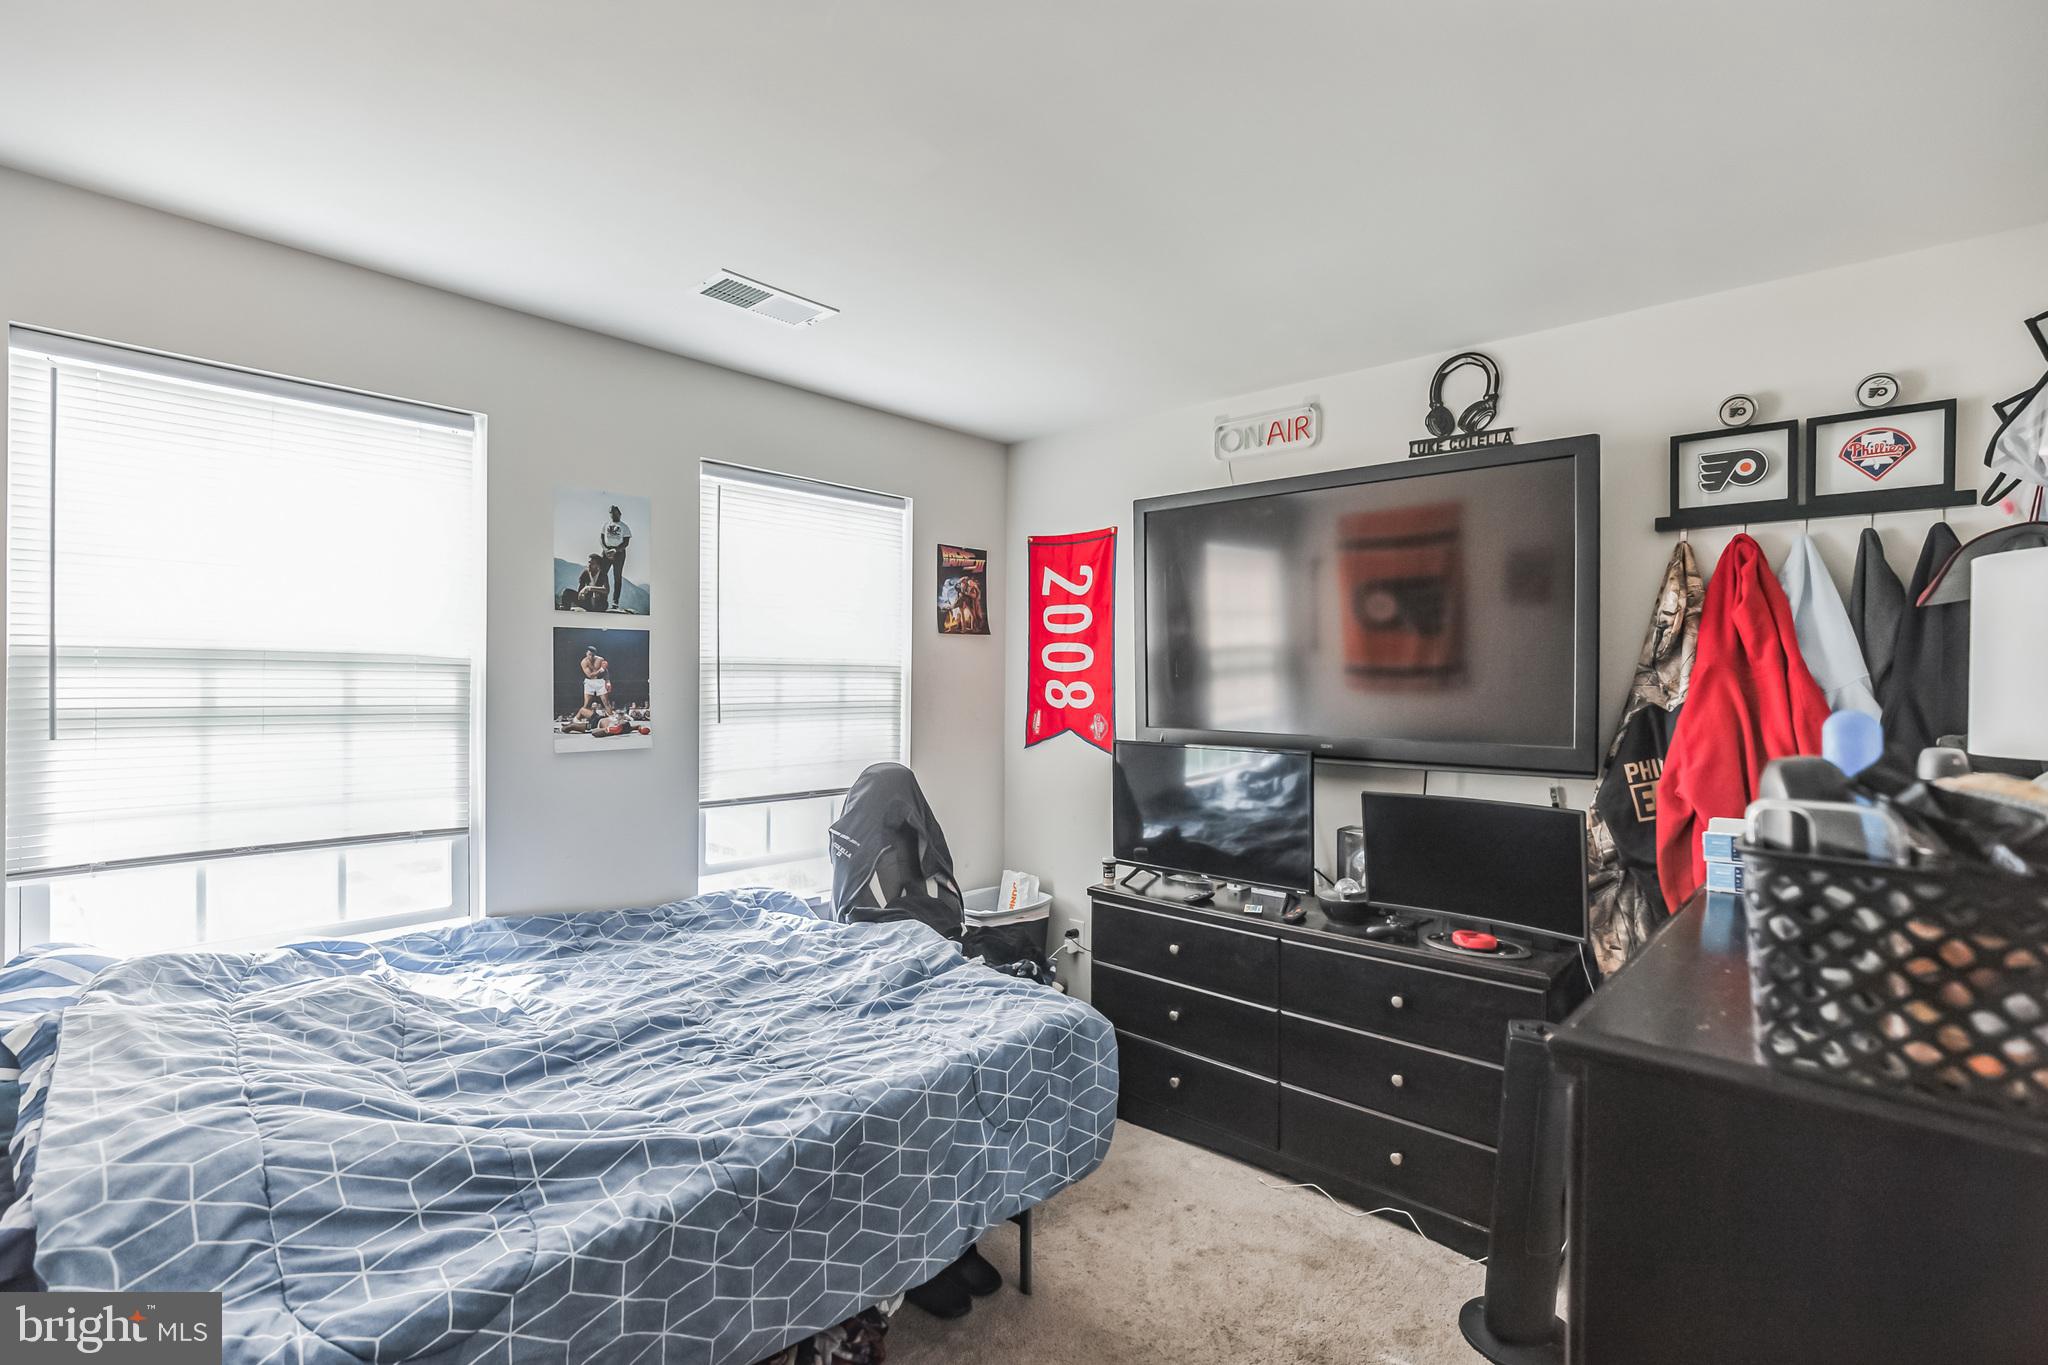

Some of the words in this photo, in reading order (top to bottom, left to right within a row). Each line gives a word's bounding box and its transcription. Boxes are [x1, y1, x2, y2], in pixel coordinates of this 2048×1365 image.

[1220, 423, 1264, 452] ON
[1266, 415, 1310, 446] AIR
[1409, 437, 1448, 458] LUKE
[1450, 430, 1513, 452] COLELLA
[1848, 441, 1905, 459] Phillies
[1041, 564, 1095, 709] 2008
